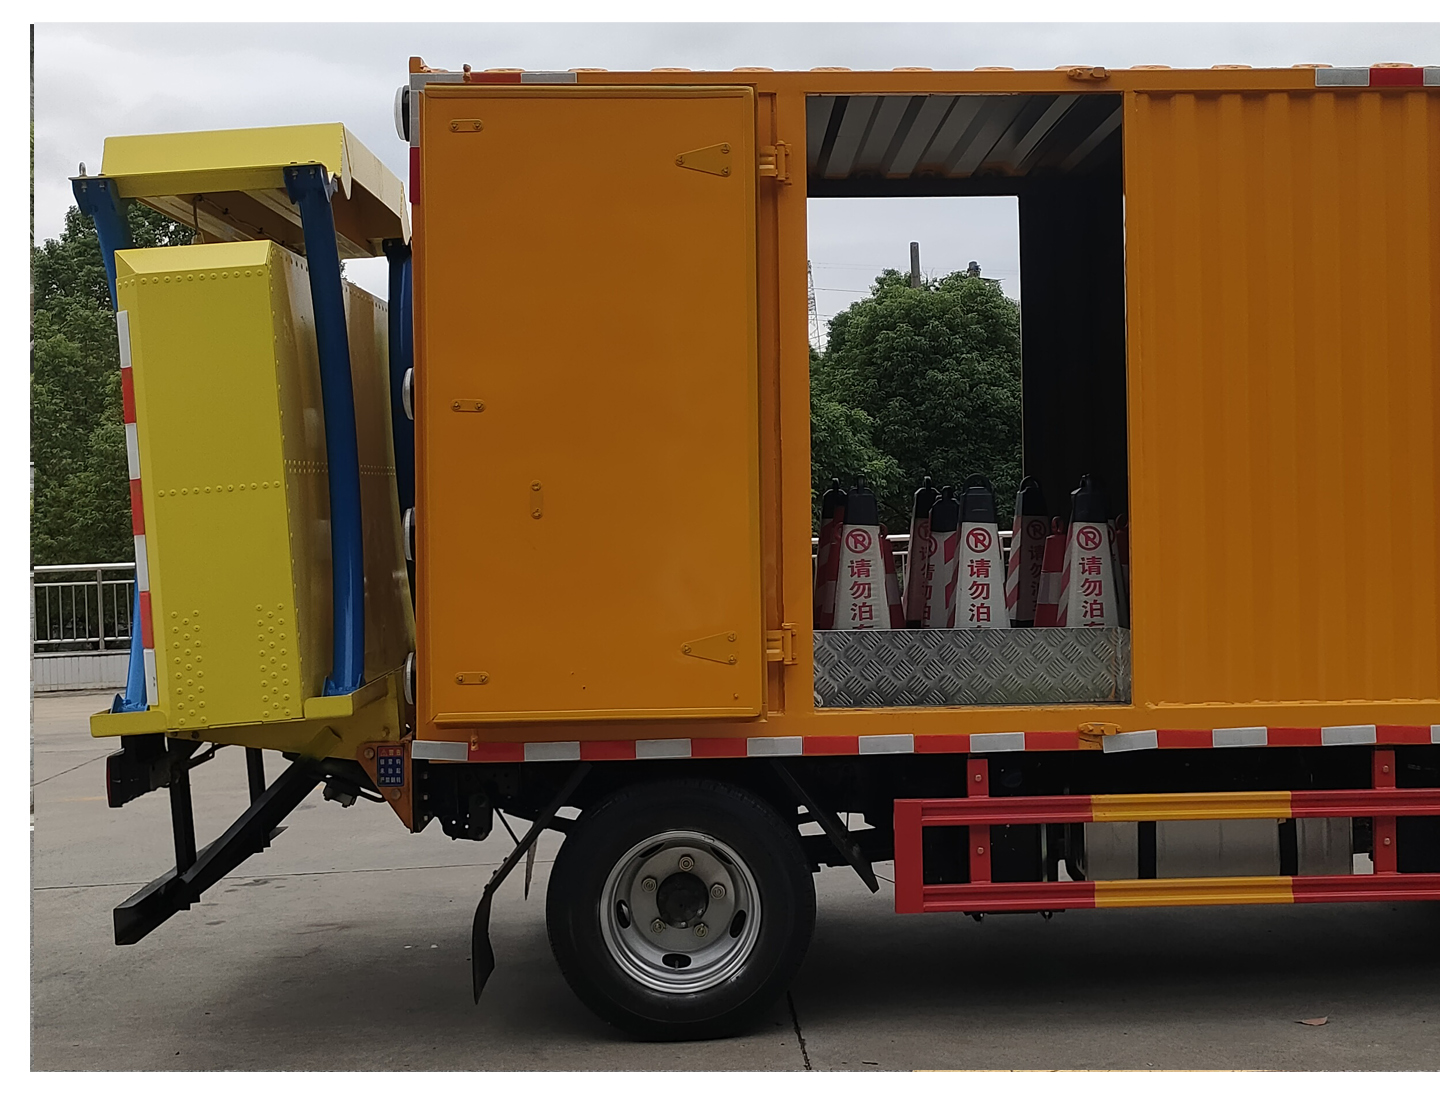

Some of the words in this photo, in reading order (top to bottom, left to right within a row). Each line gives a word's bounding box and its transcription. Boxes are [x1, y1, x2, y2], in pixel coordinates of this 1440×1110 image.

[848, 559, 874, 630] 请勿泊
[967, 558, 991, 629] 请勿泊
